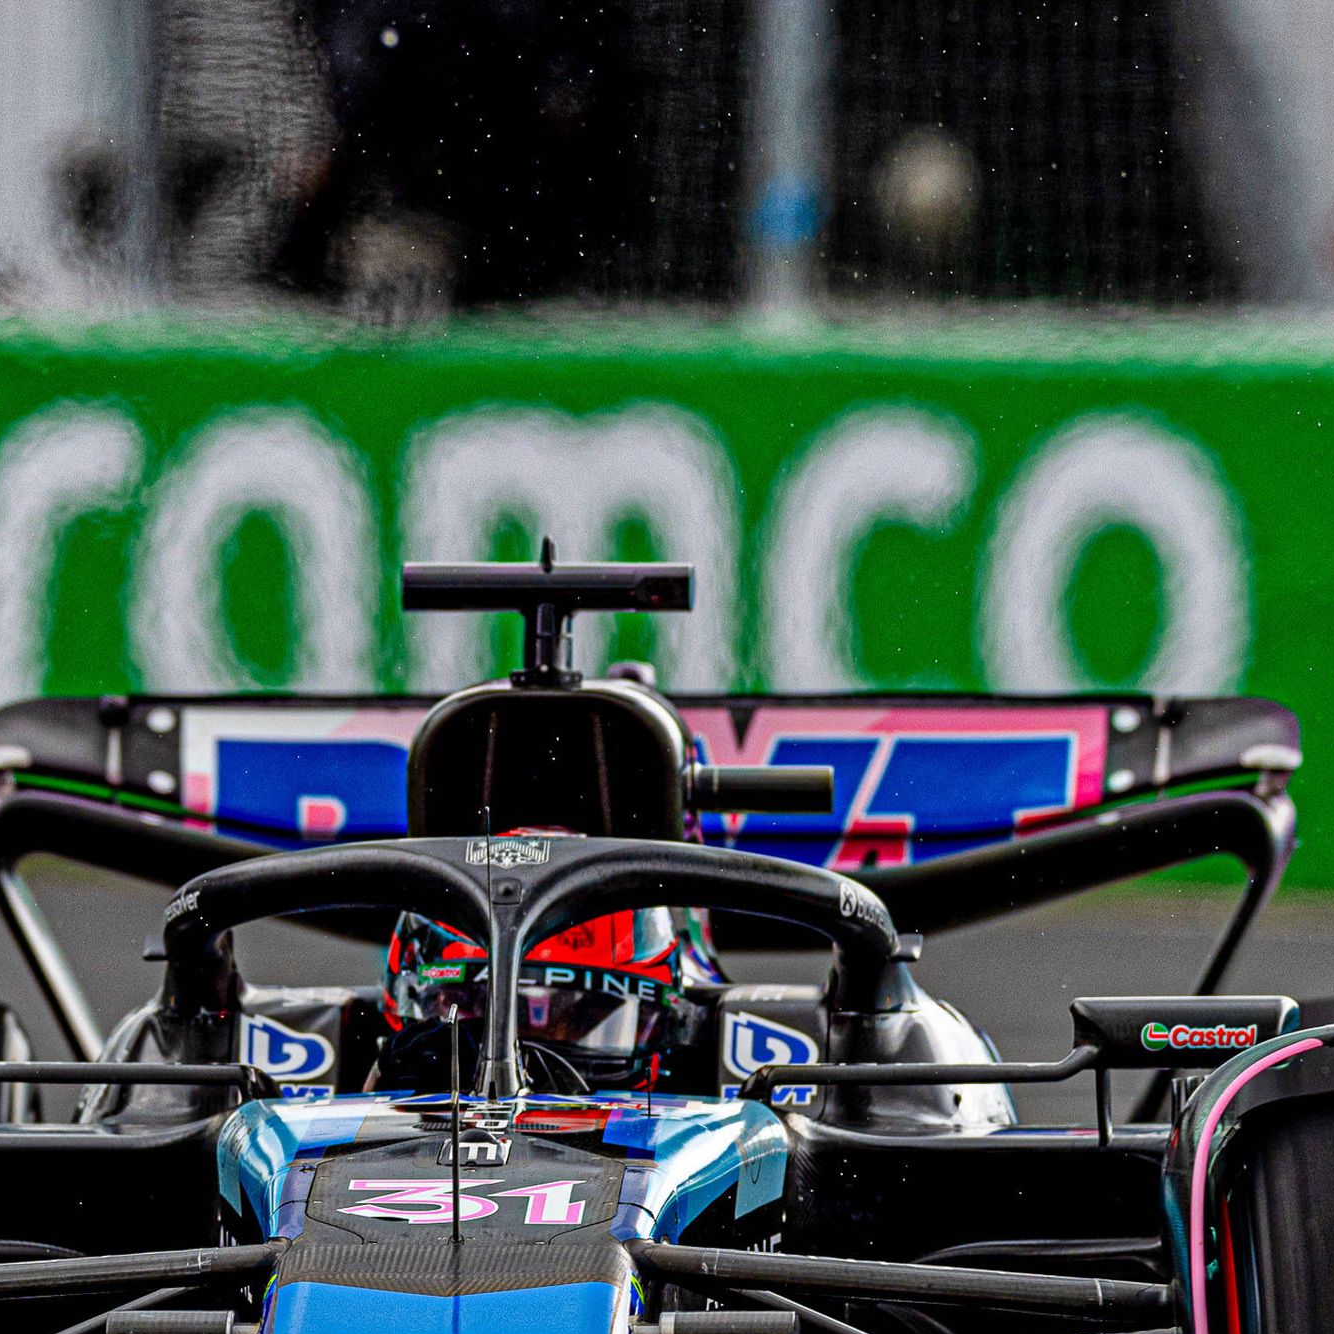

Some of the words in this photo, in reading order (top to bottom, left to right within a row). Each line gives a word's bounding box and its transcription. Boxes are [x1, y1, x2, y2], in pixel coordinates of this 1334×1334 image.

[473, 964, 656, 1002] PINE
[1168, 1023, 1258, 1048] Castrol
[335, 1178, 589, 1226] 31
